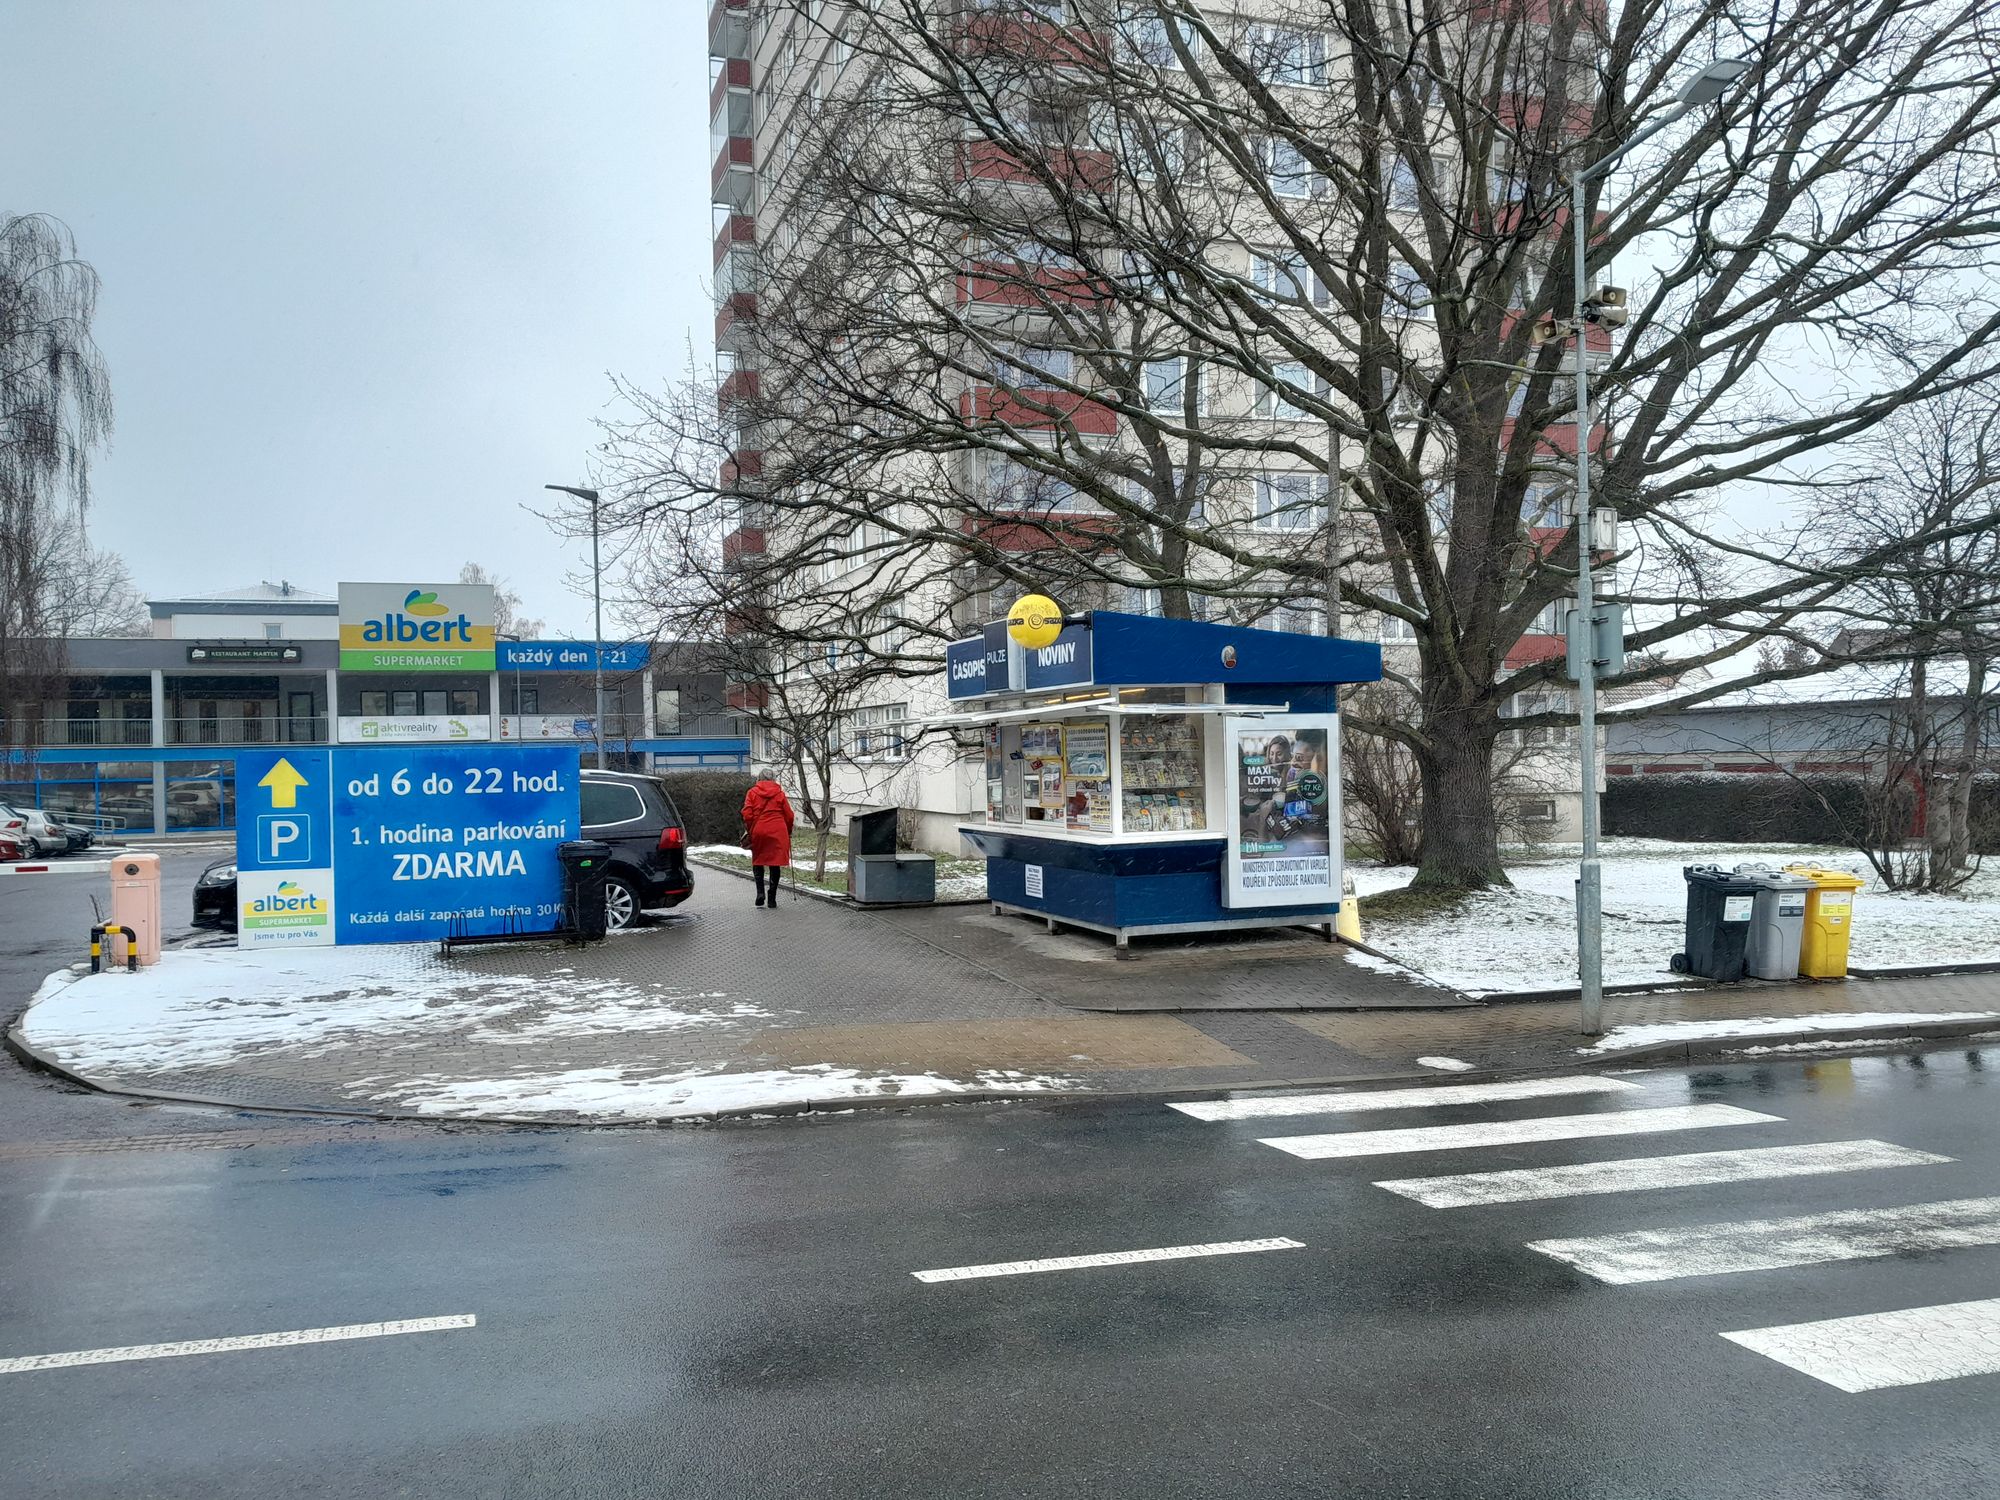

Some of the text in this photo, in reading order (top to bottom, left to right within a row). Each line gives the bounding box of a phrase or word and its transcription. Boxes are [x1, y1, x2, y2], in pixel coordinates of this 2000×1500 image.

[363, 614, 472, 643] albert
[374, 655, 463, 666] SUPERMARKET
[507, 648, 554, 666] každý
[559, 649, 588, 663] den
[986, 649, 1006, 665] PULZE
[1037, 641, 1076, 667] NOVINY
[381, 722, 438, 733] aktivreality
[1247, 766, 1271, 775] MAXI
[348, 768, 565, 796] od 6 do 22 hod.
[1247, 776, 1282, 786] LOFTky
[271, 821, 299, 857] P
[351, 819, 567, 846] 1. hodina parkování
[392, 850, 527, 881] ZDARMA
[1243, 861, 1274, 873] MINISTERSTVO
[1276, 857, 1309, 872] ZDRAVOTNICTVÍ
[1243, 873, 1266, 888] KOUŘENÍ
[1268, 873, 1298, 887] ZPŮSOBUJE
[253, 893, 317, 912] albert
[259, 917, 312, 926] SUPERMARKET
[350, 910, 389, 924] Každá
[394, 908, 425, 922] další
[429, 907, 485, 923] započatá
[490, 904, 531, 917] hodina
[537, 903, 551, 917] 30
[254, 932, 275, 941] Jsme
[287, 931, 301, 940] pro
[303, 930, 318, 938] Vás
